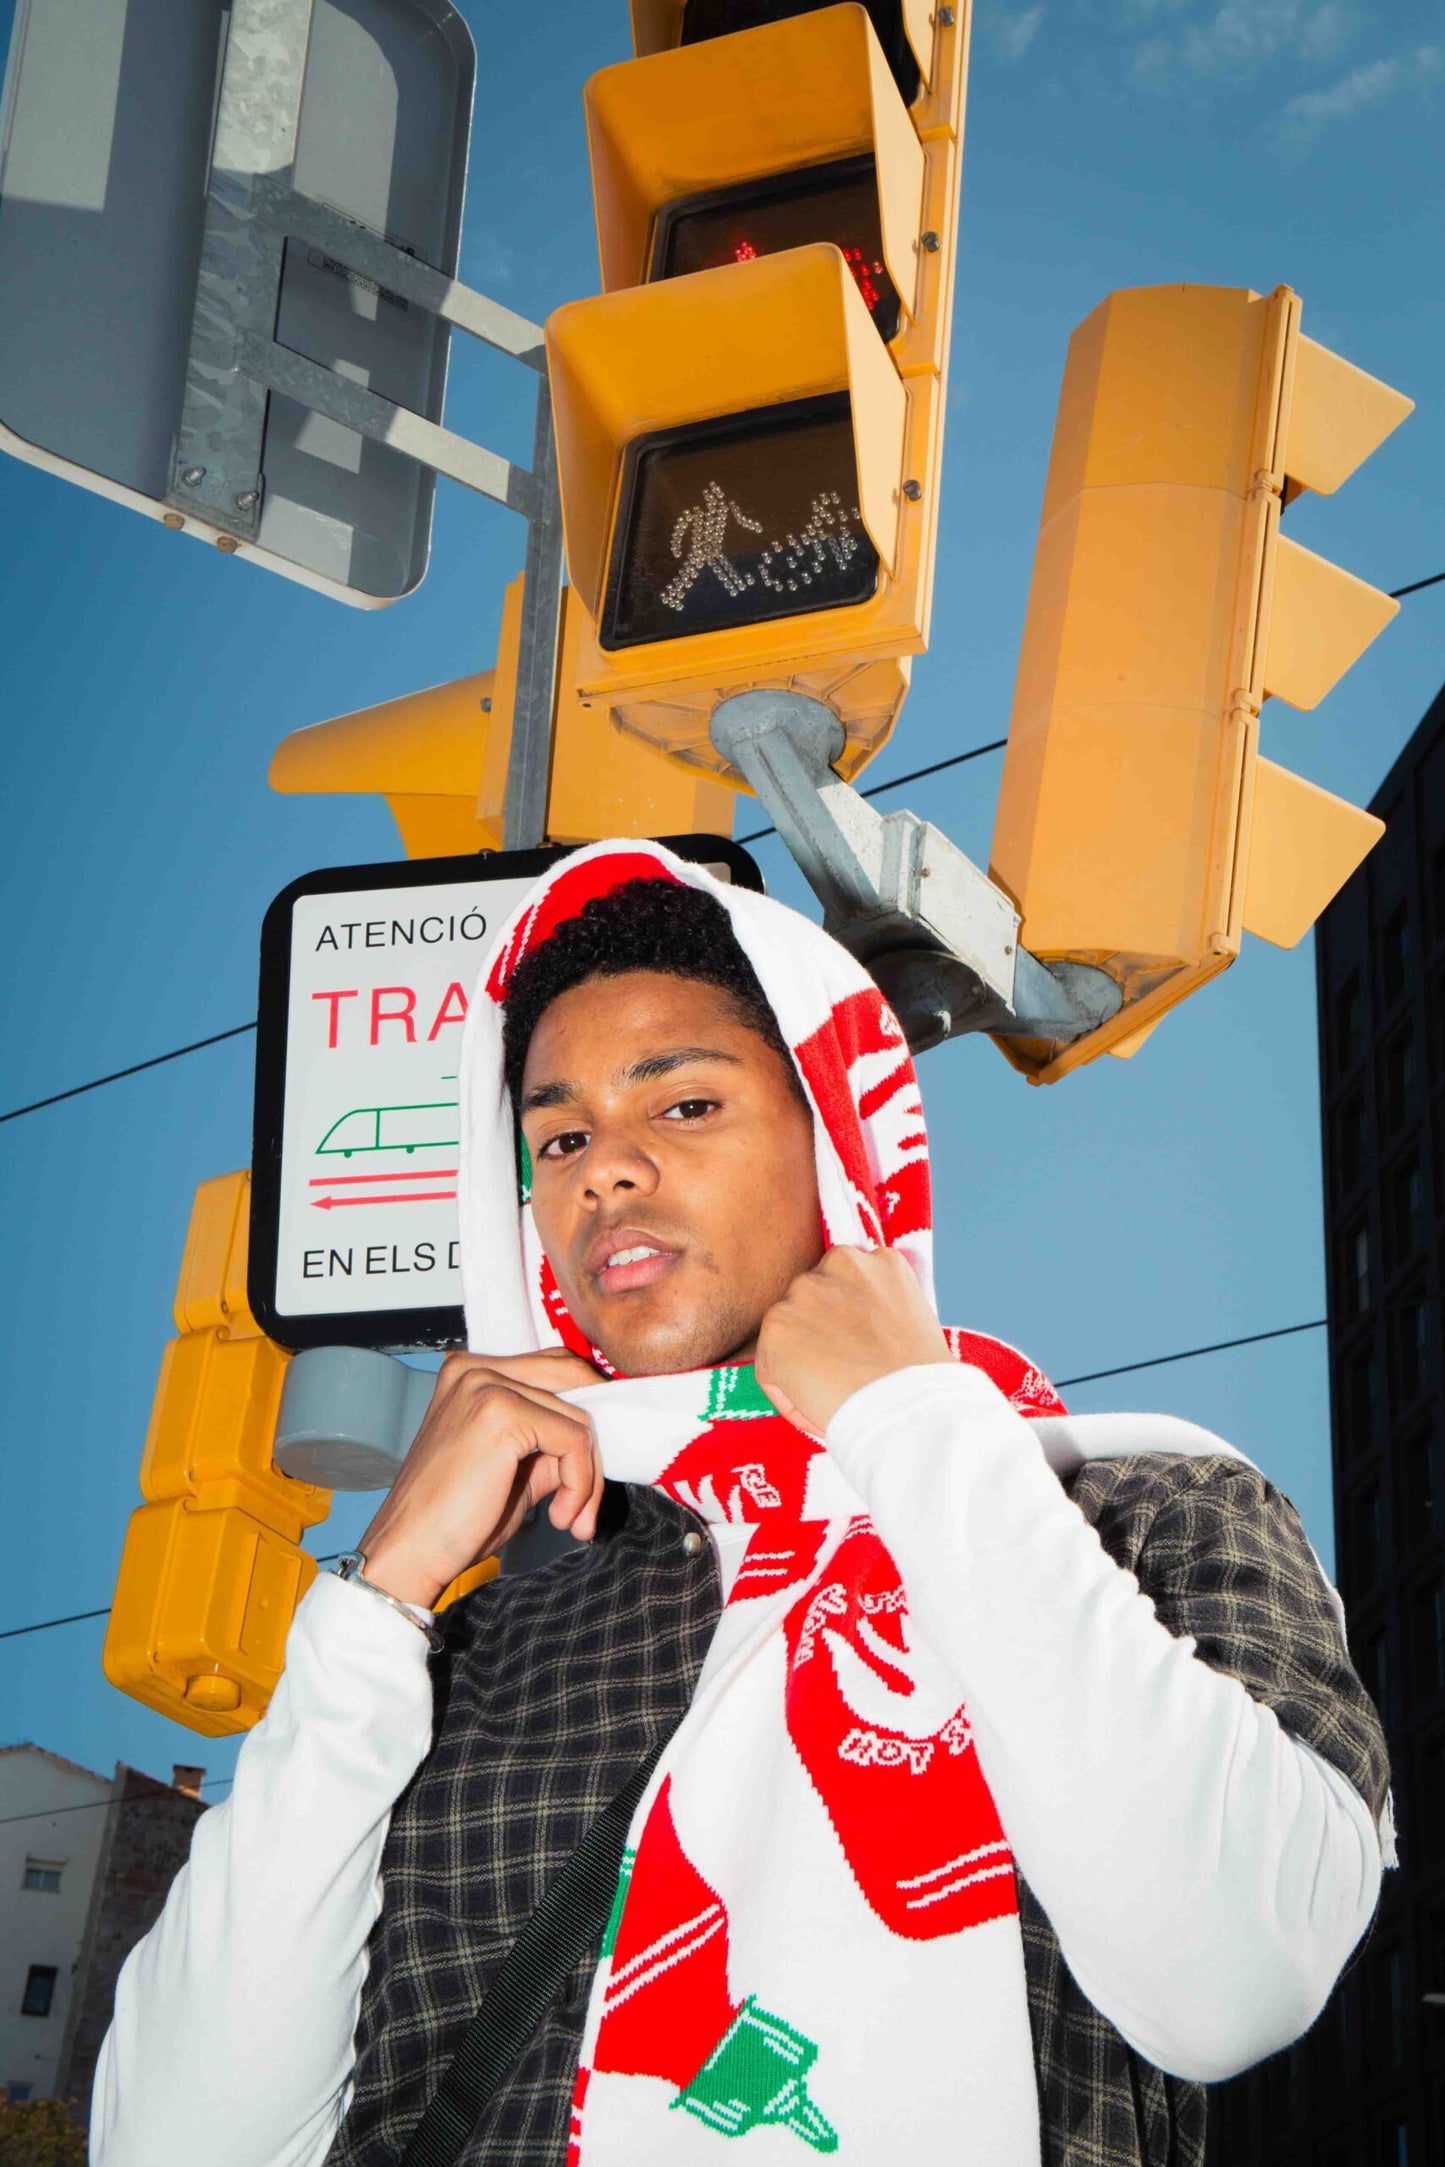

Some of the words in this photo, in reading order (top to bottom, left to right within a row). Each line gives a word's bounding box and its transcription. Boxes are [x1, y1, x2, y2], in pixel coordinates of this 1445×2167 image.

[316, 906, 487, 951] ATENCIÓ
[311, 981, 470, 1049] TRA
[303, 1249, 353, 1279] EN
[366, 1242, 436, 1275] ELS
[838, 1728, 935, 1776] HOT
